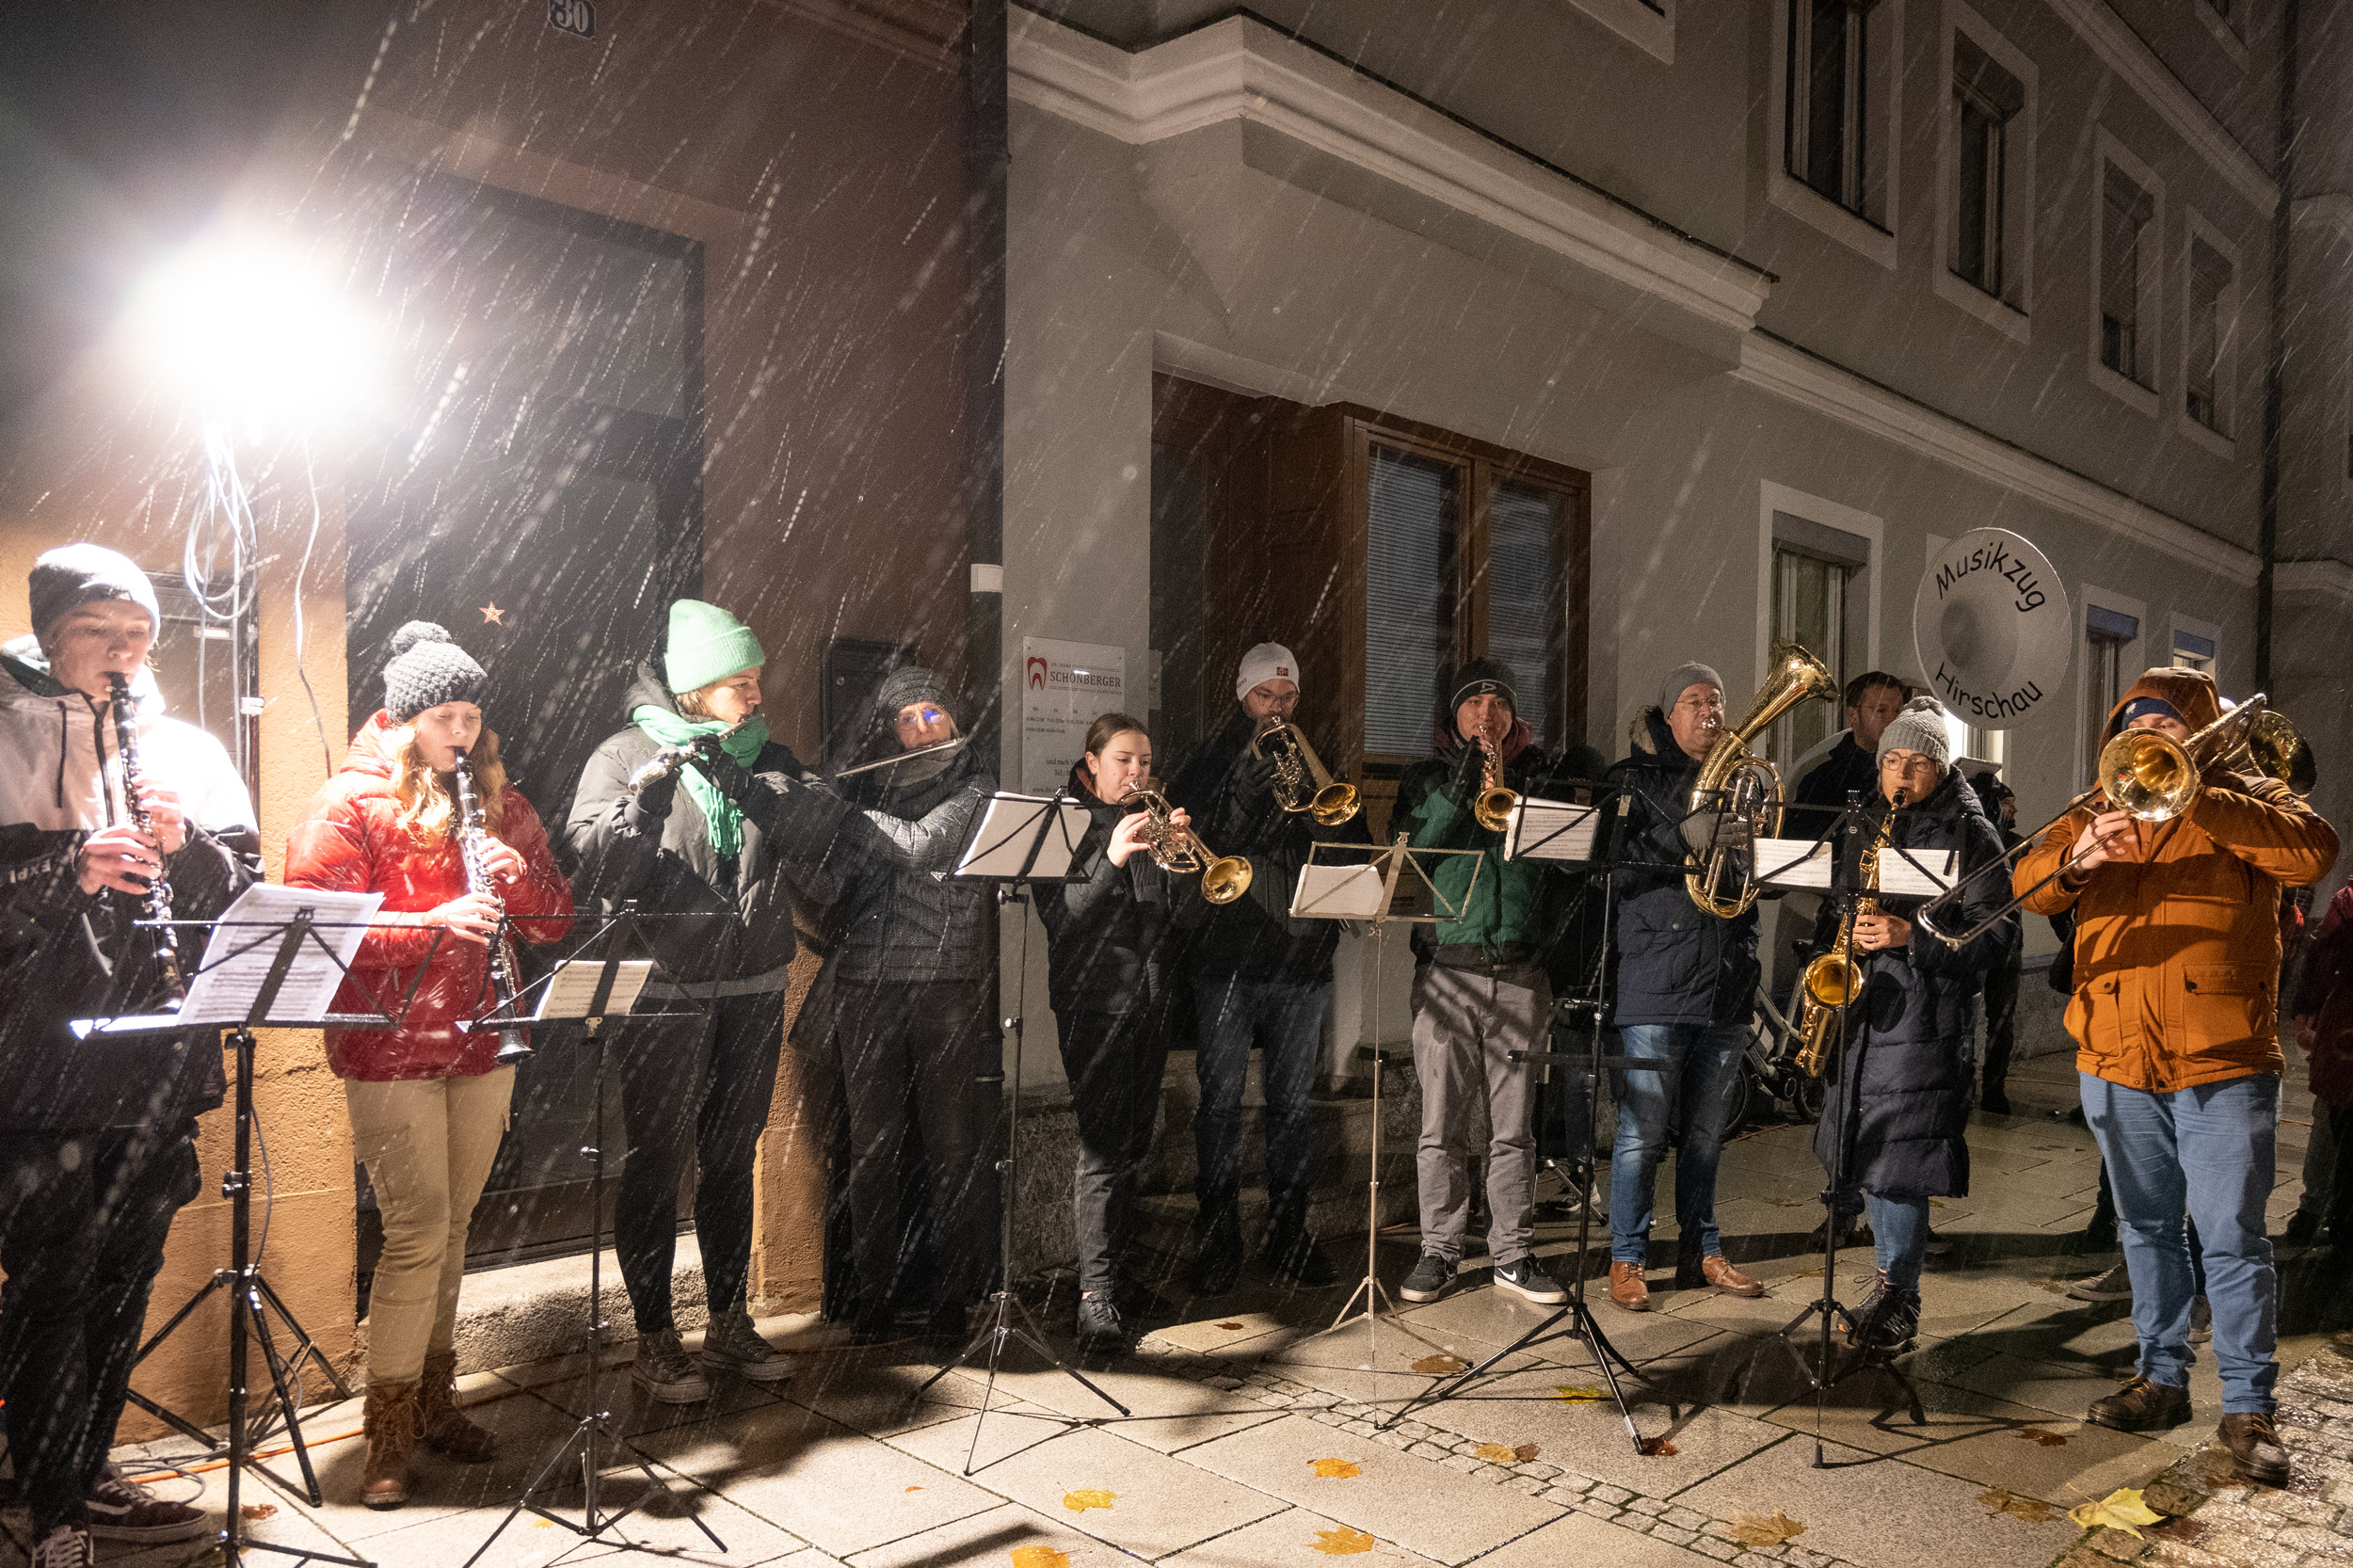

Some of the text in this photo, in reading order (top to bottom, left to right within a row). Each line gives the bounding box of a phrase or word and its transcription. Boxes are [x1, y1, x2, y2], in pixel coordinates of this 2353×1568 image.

[555, 0, 589, 33] 30
[1936, 542, 2046, 612] Musikzug
[1935, 662, 2043, 719] Hirschau
